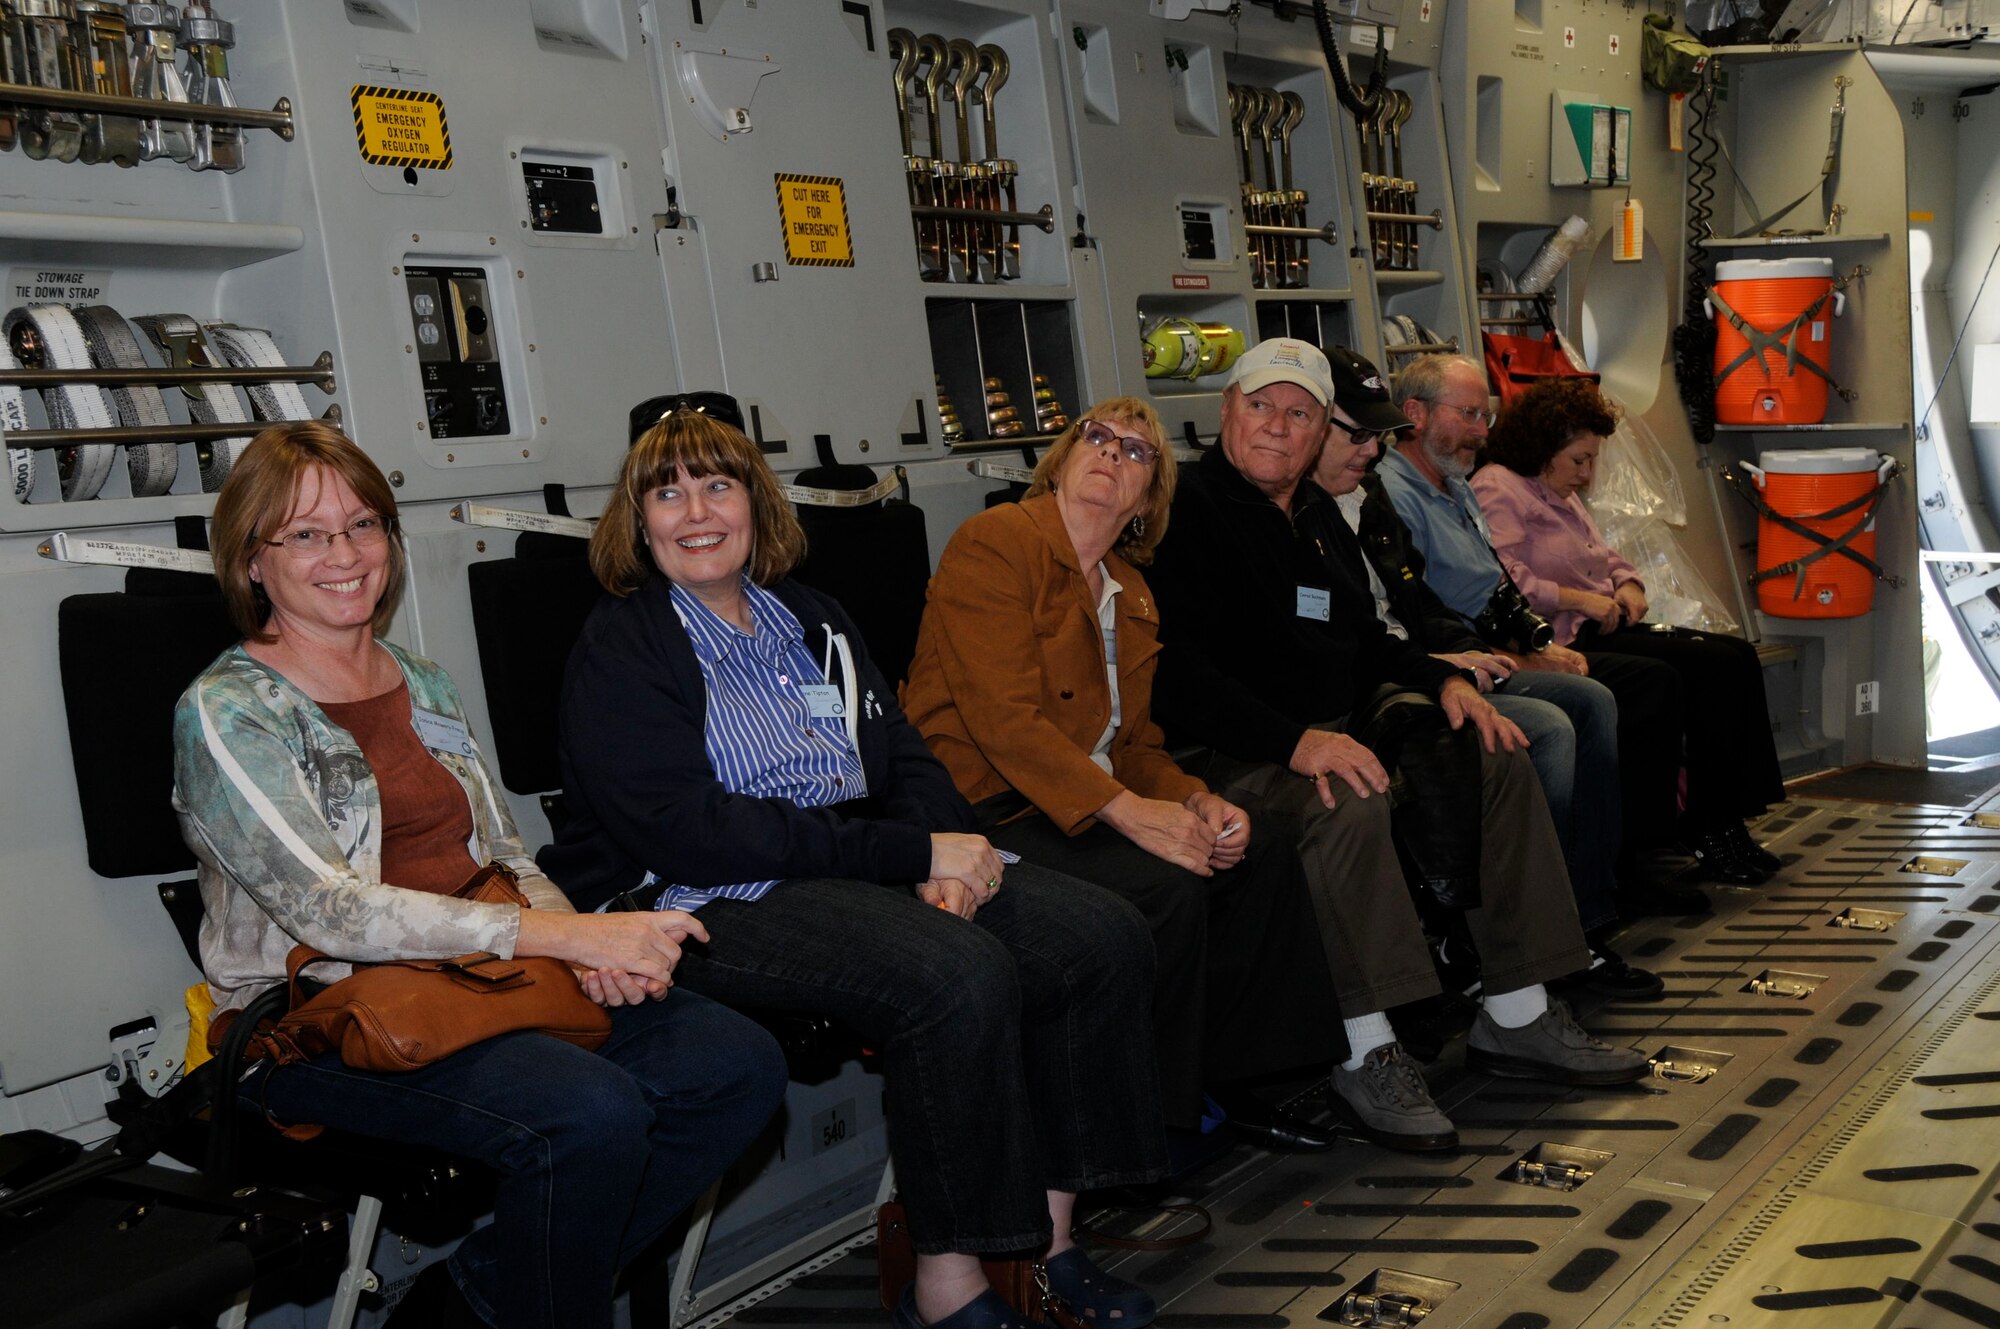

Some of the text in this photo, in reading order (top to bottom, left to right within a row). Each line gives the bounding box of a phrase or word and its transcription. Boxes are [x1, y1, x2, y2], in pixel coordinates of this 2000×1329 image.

[1771, 44, 1801, 53] NO STEP
[375, 102, 424, 113] CENTERLINE SEAT
[376, 112, 426, 127] EMERGENCY
[387, 126, 421, 140] OXYGEN
[382, 140, 431, 154] REGULATOR
[563, 167, 568, 177] 2
[792, 187, 831, 203] CUT HERE
[806, 205, 822, 219] FOR
[793, 222, 839, 237] EMERGENCY
[810, 240, 827, 253] EXIT
[36, 272, 85, 284] STOWAGE
[16, 286, 100, 299] TIE DOWN STRAP
[15, 463, 29, 495] 5000
[823, 1119, 846, 1147] 540
